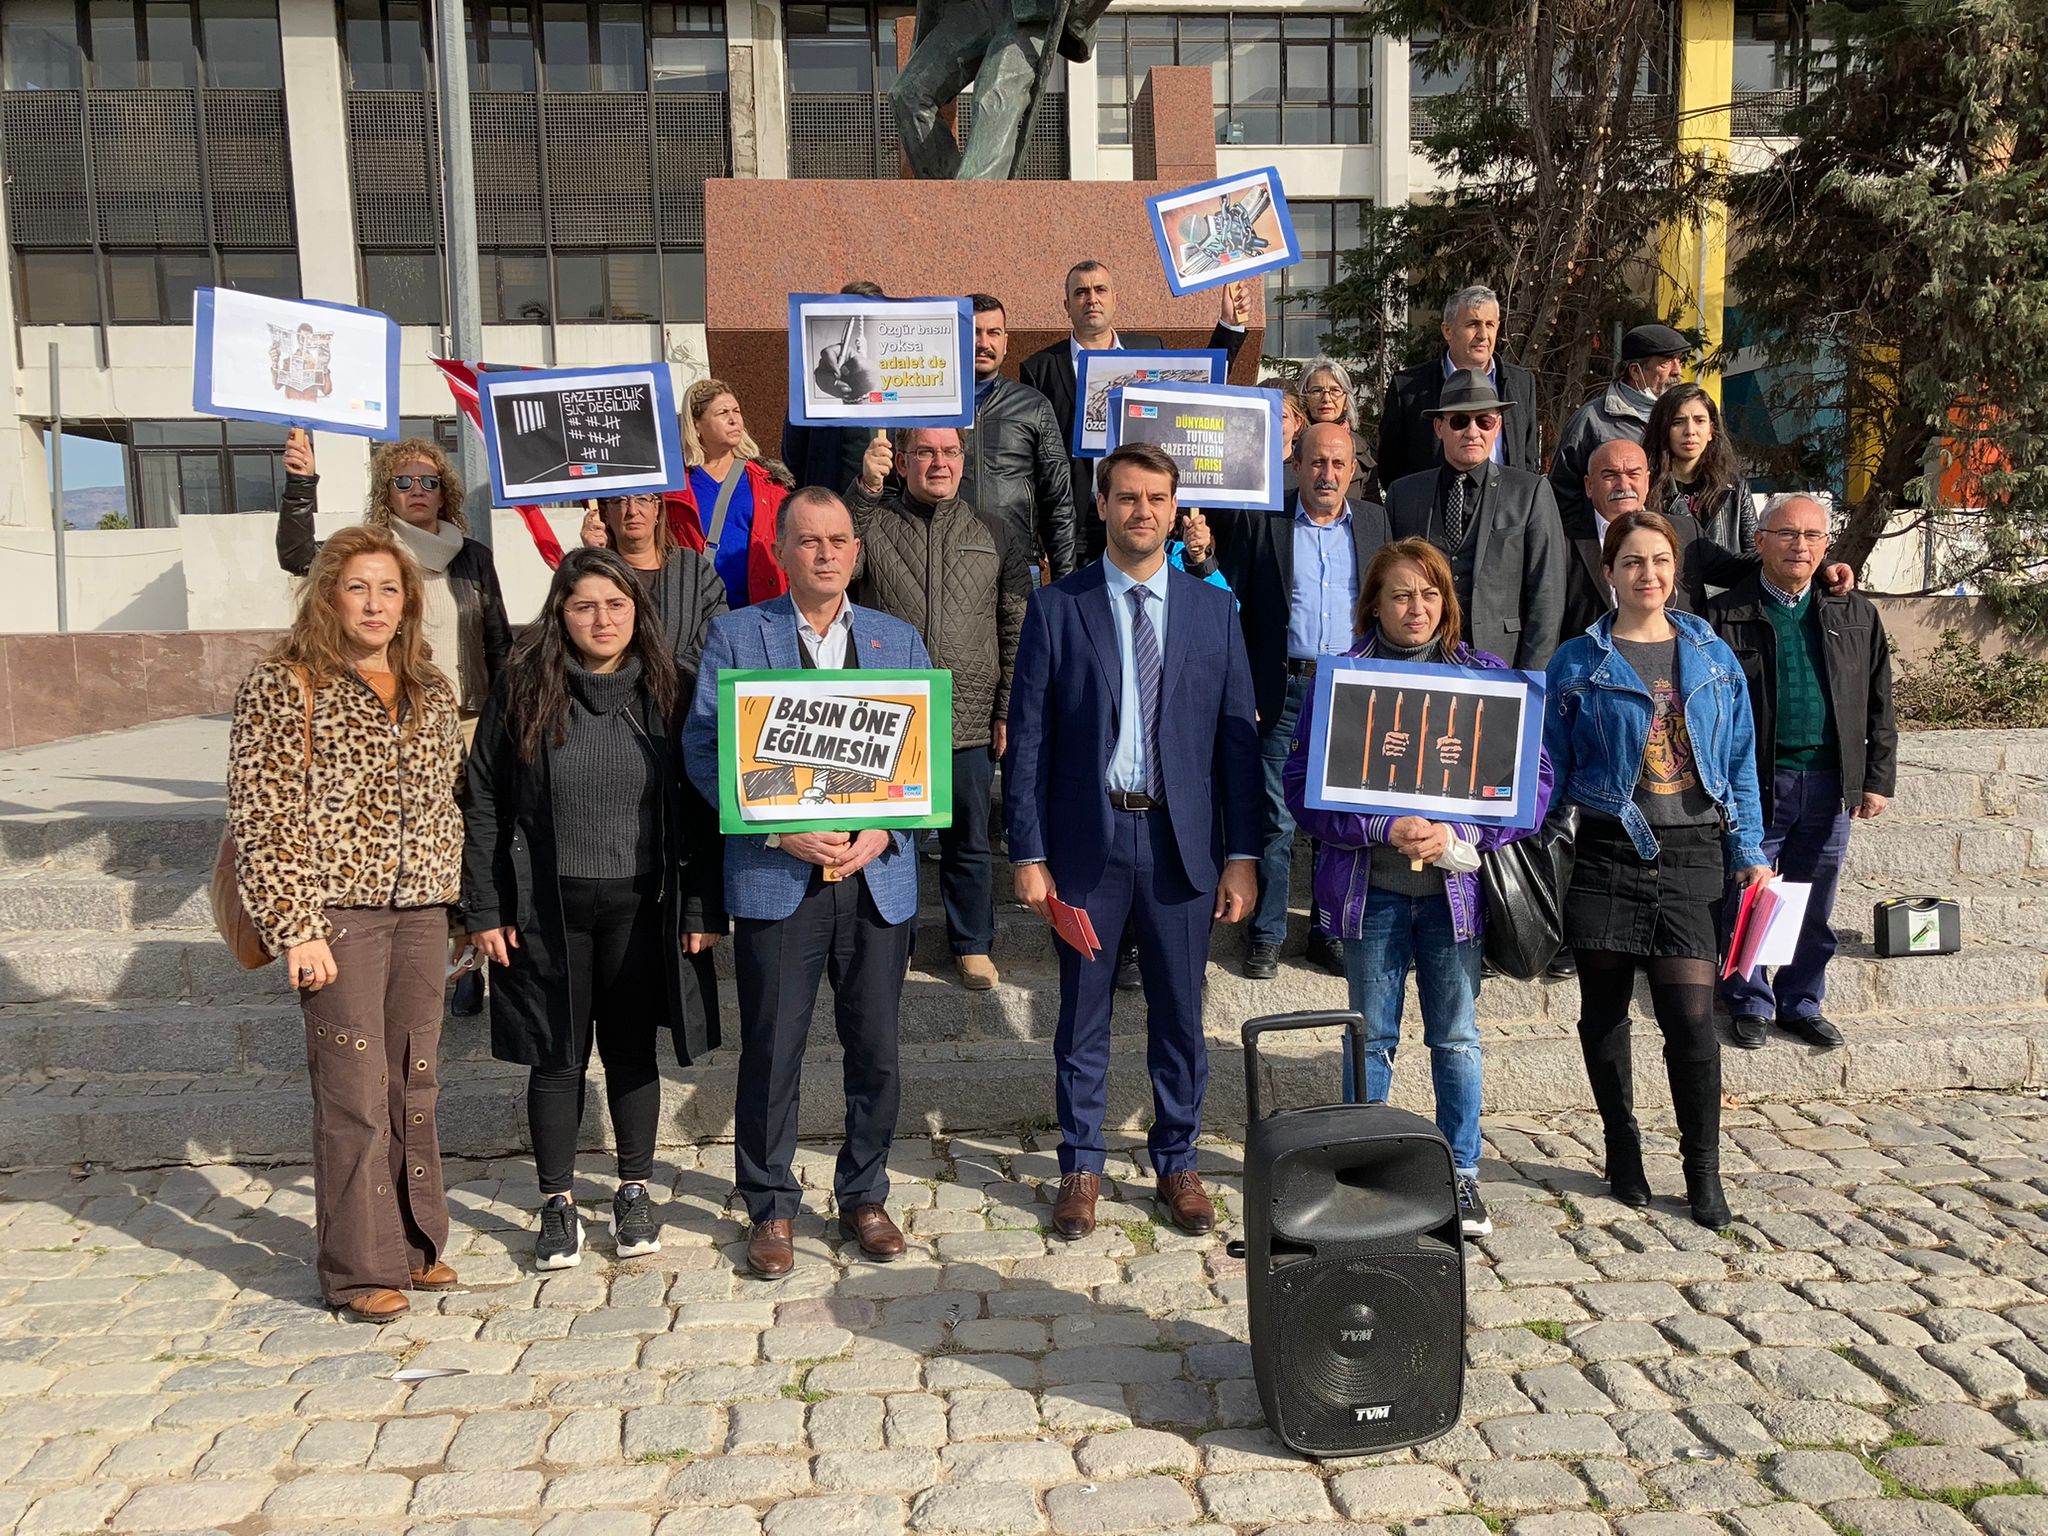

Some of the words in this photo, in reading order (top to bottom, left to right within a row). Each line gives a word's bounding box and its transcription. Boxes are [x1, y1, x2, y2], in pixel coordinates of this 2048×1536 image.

[878, 323, 915, 338] Özgür
[917, 324, 952, 335] basın
[880, 340, 923, 355] yoksa
[879, 356, 925, 369] adalet
[928, 355, 946, 369] de
[880, 371, 944, 391] yoktur!
[1085, 419, 1106, 431] ÖZG
[1175, 414, 1224, 431] DÜNYADAKİ
[1186, 430, 1224, 444] TUTUKLU
[1194, 457, 1222, 471] YARISI
[1178, 469, 1224, 485] ÜRKİYE'DE
[774, 697, 847, 729] BASIN
[849, 701, 901, 737] ÖNE
[763, 723, 890, 769] EĞİLMESİN
[1340, 1329, 1373, 1341] TVM
[1355, 1405, 1392, 1421] TVM
